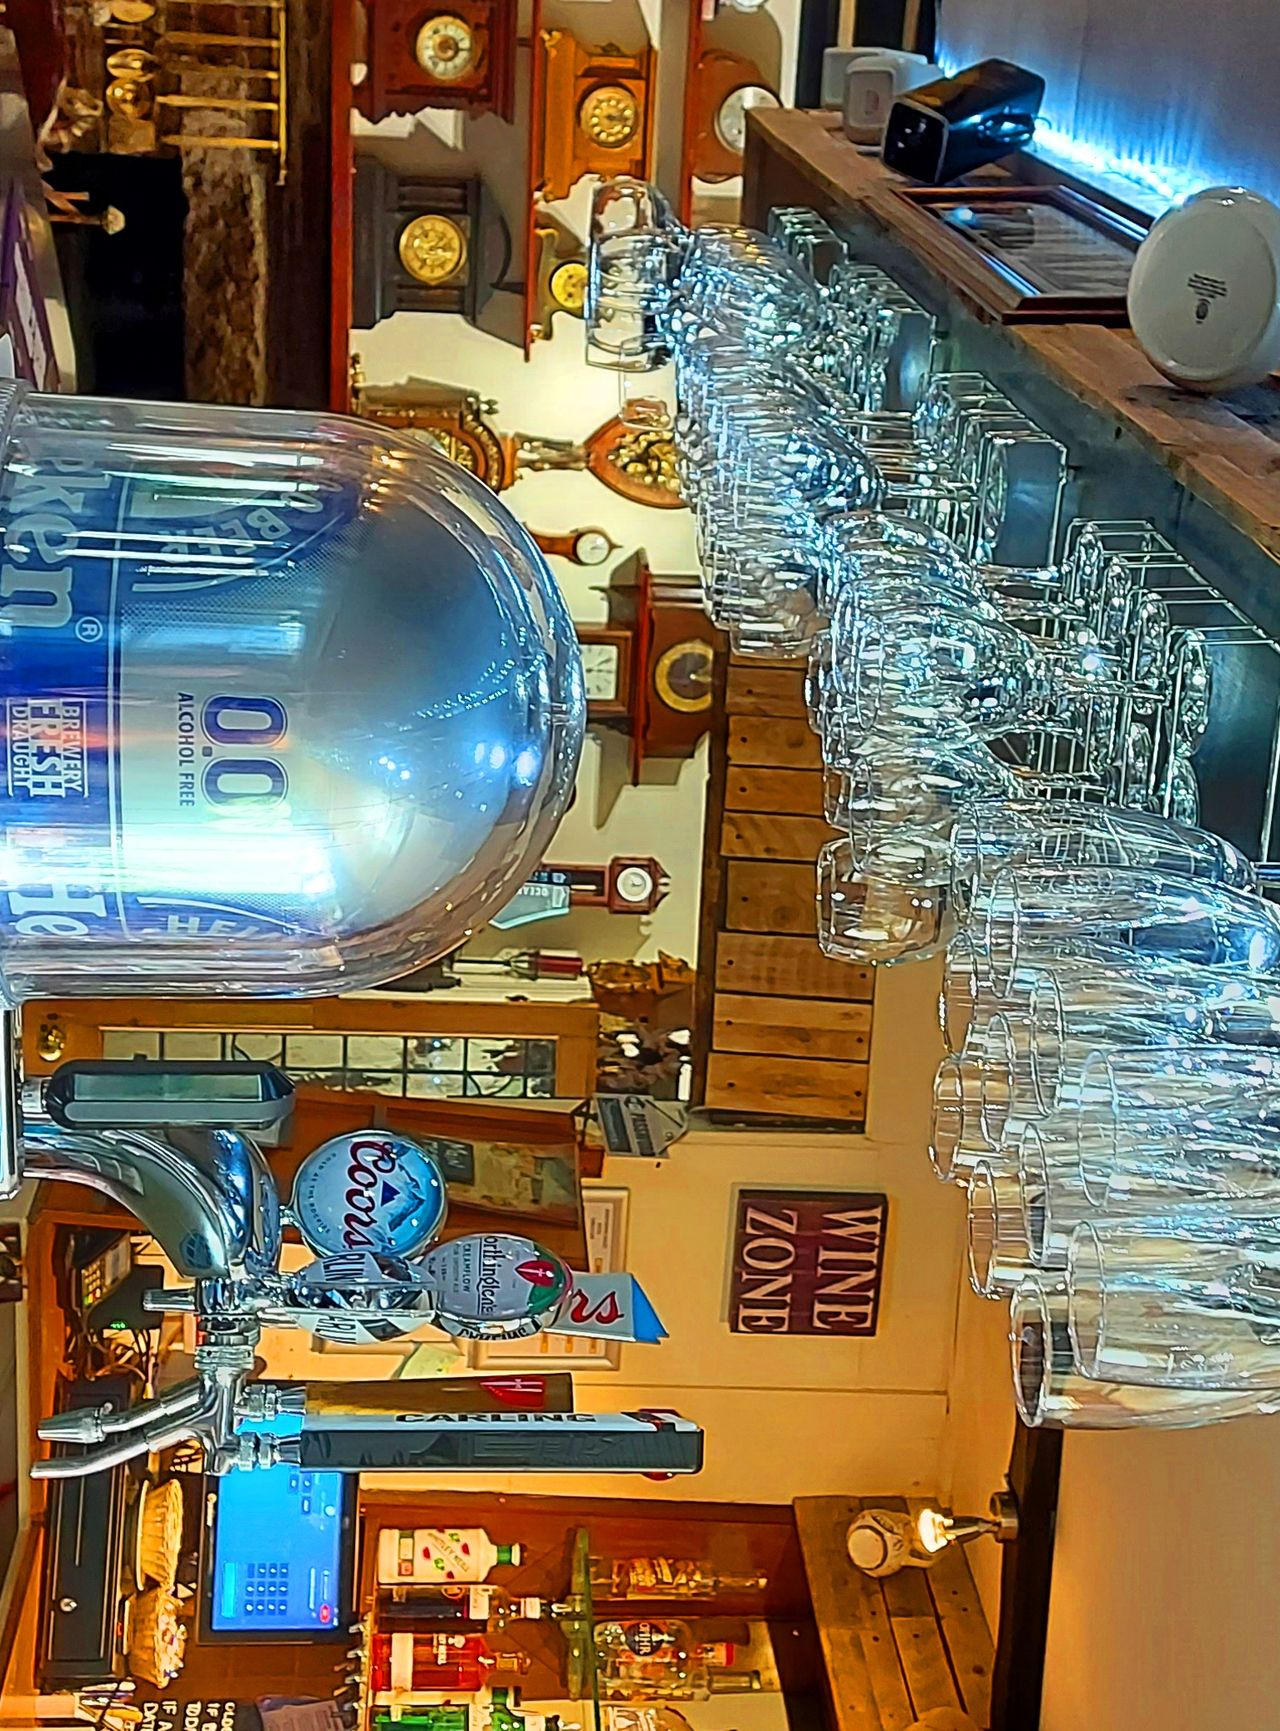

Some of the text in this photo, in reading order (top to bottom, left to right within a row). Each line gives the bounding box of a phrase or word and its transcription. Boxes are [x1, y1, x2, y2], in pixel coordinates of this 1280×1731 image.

[12, 706, 31, 789] DRAUGHT
[29, 701, 64, 797] FRESH
[62, 706, 82, 792] BREWERY
[178, 692, 195, 806] ALCOHOL FREE
[201, 695, 288, 807] 0.0
[342, 1140, 396, 1250] Coors
[462, 1244, 472, 1293] CREAMFLOW
[737, 1207, 798, 1333] ZONE
[812, 1206, 882, 1329] WINE
[394, 1413, 597, 1424] CARLING
[162, 1700, 177, 1715] IF
[206, 1702, 221, 1717] IF
